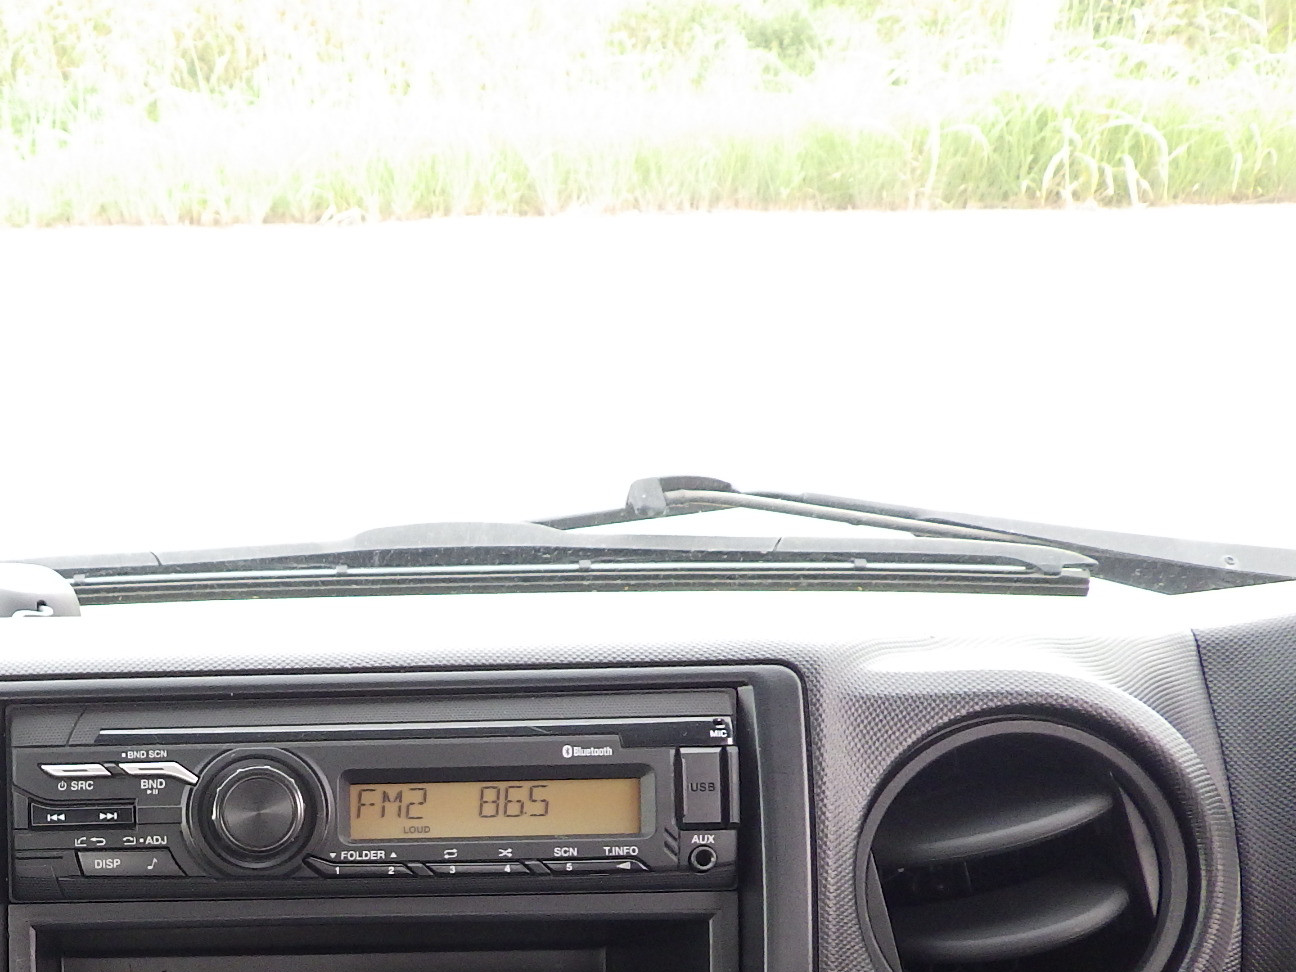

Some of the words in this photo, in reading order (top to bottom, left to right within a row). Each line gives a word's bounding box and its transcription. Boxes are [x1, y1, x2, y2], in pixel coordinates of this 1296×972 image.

[709, 729, 727, 738] MIC
[127, 750, 146, 759] BND
[148, 749, 167, 758] SCN
[573, 747, 613, 756] Bluetooth
[70, 781, 94, 790] SRC
[140, 779, 166, 789] BND
[690, 782, 716, 793] USB
[356, 787, 428, 820] FM2
[403, 825, 431, 834] LOUD
[145, 836, 167, 845] ADJ
[691, 834, 715, 844] AUX
[340, 850, 386, 860] FOLDER
[553, 846, 578, 857] SCN
[603, 845, 639, 856] T.INFO
[94, 859, 121, 869] DISP
[504, 864, 511, 873] 4
[565, 862, 573, 871] 5
[335, 867, 340, 875] 1
[387, 866, 395, 875] 2
[449, 866, 456, 874] 3
